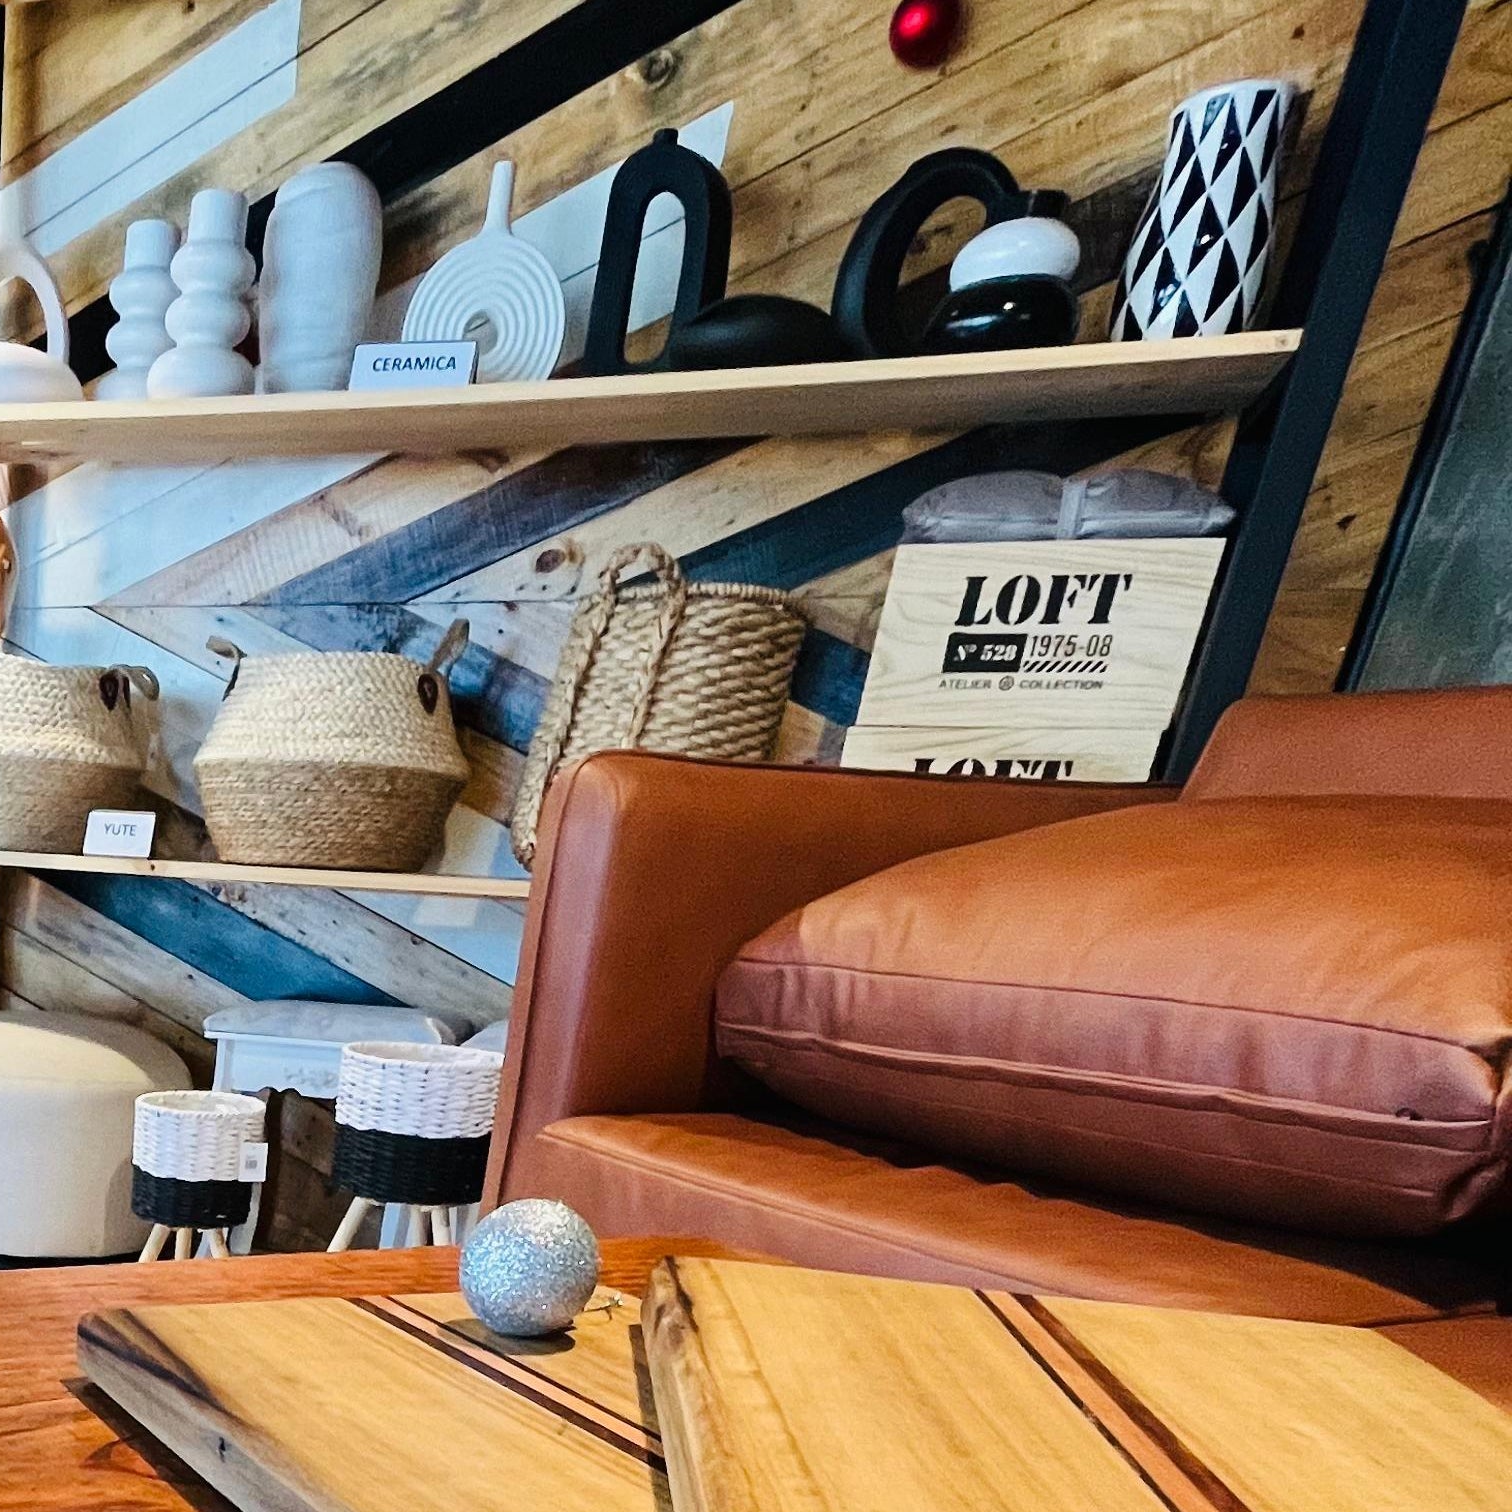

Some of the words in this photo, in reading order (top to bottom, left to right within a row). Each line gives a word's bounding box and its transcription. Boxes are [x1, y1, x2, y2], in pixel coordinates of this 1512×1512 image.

[372, 356, 456, 372] CERAMICA
[954, 573, 1133, 627] LOFT
[1028, 633, 1114, 658] 1975-08
[939, 678, 992, 690] ATELIER
[1019, 678, 1104, 691] COLLECTION
[104, 823, 137, 837] YUTE
